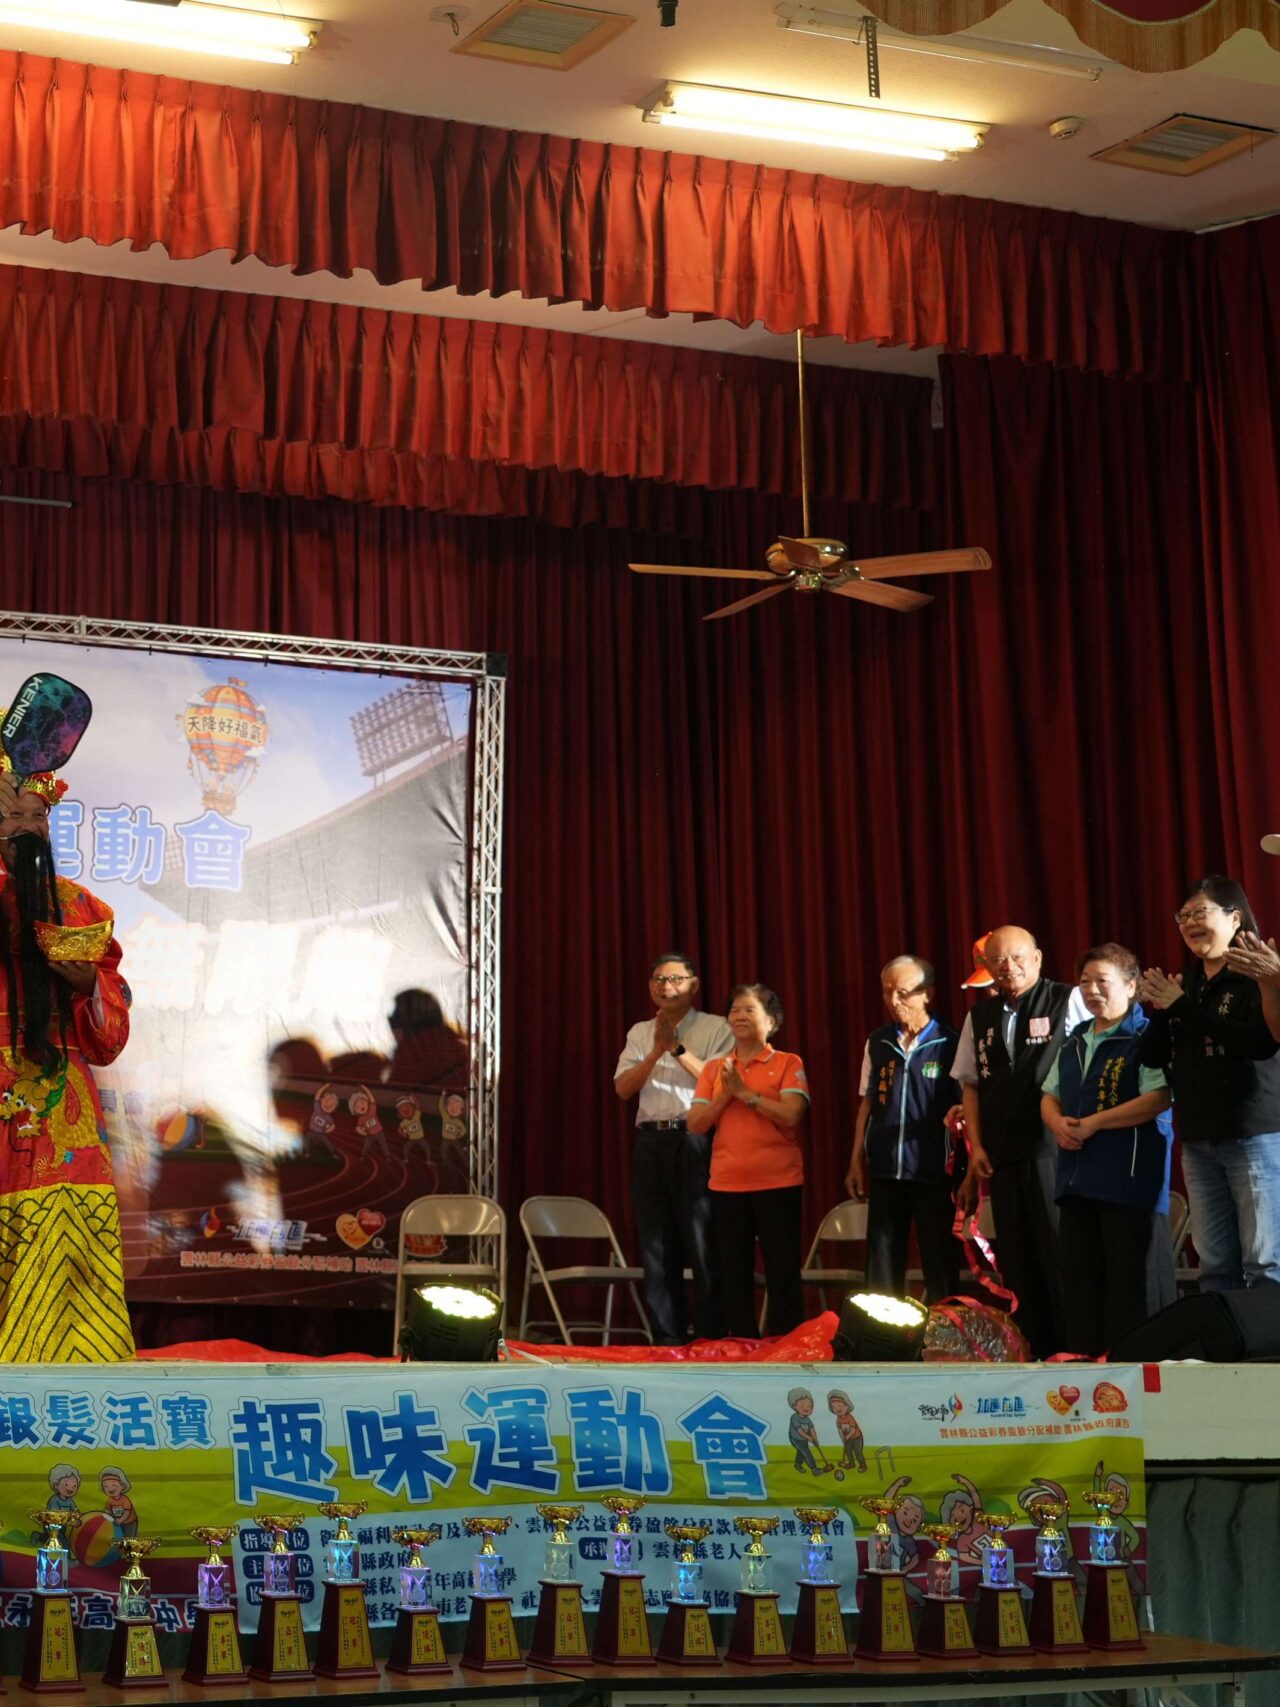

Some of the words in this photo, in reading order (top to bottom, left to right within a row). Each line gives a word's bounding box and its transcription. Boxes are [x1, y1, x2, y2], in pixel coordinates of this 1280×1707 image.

[2, 676, 43, 738] KENIER
[188, 715, 262, 743] 天降好福氣
[229, 1384, 769, 1505] 趣味運動會
[244, 1531, 310, 1549] 指位
[250, 1557, 312, 1575] 主位
